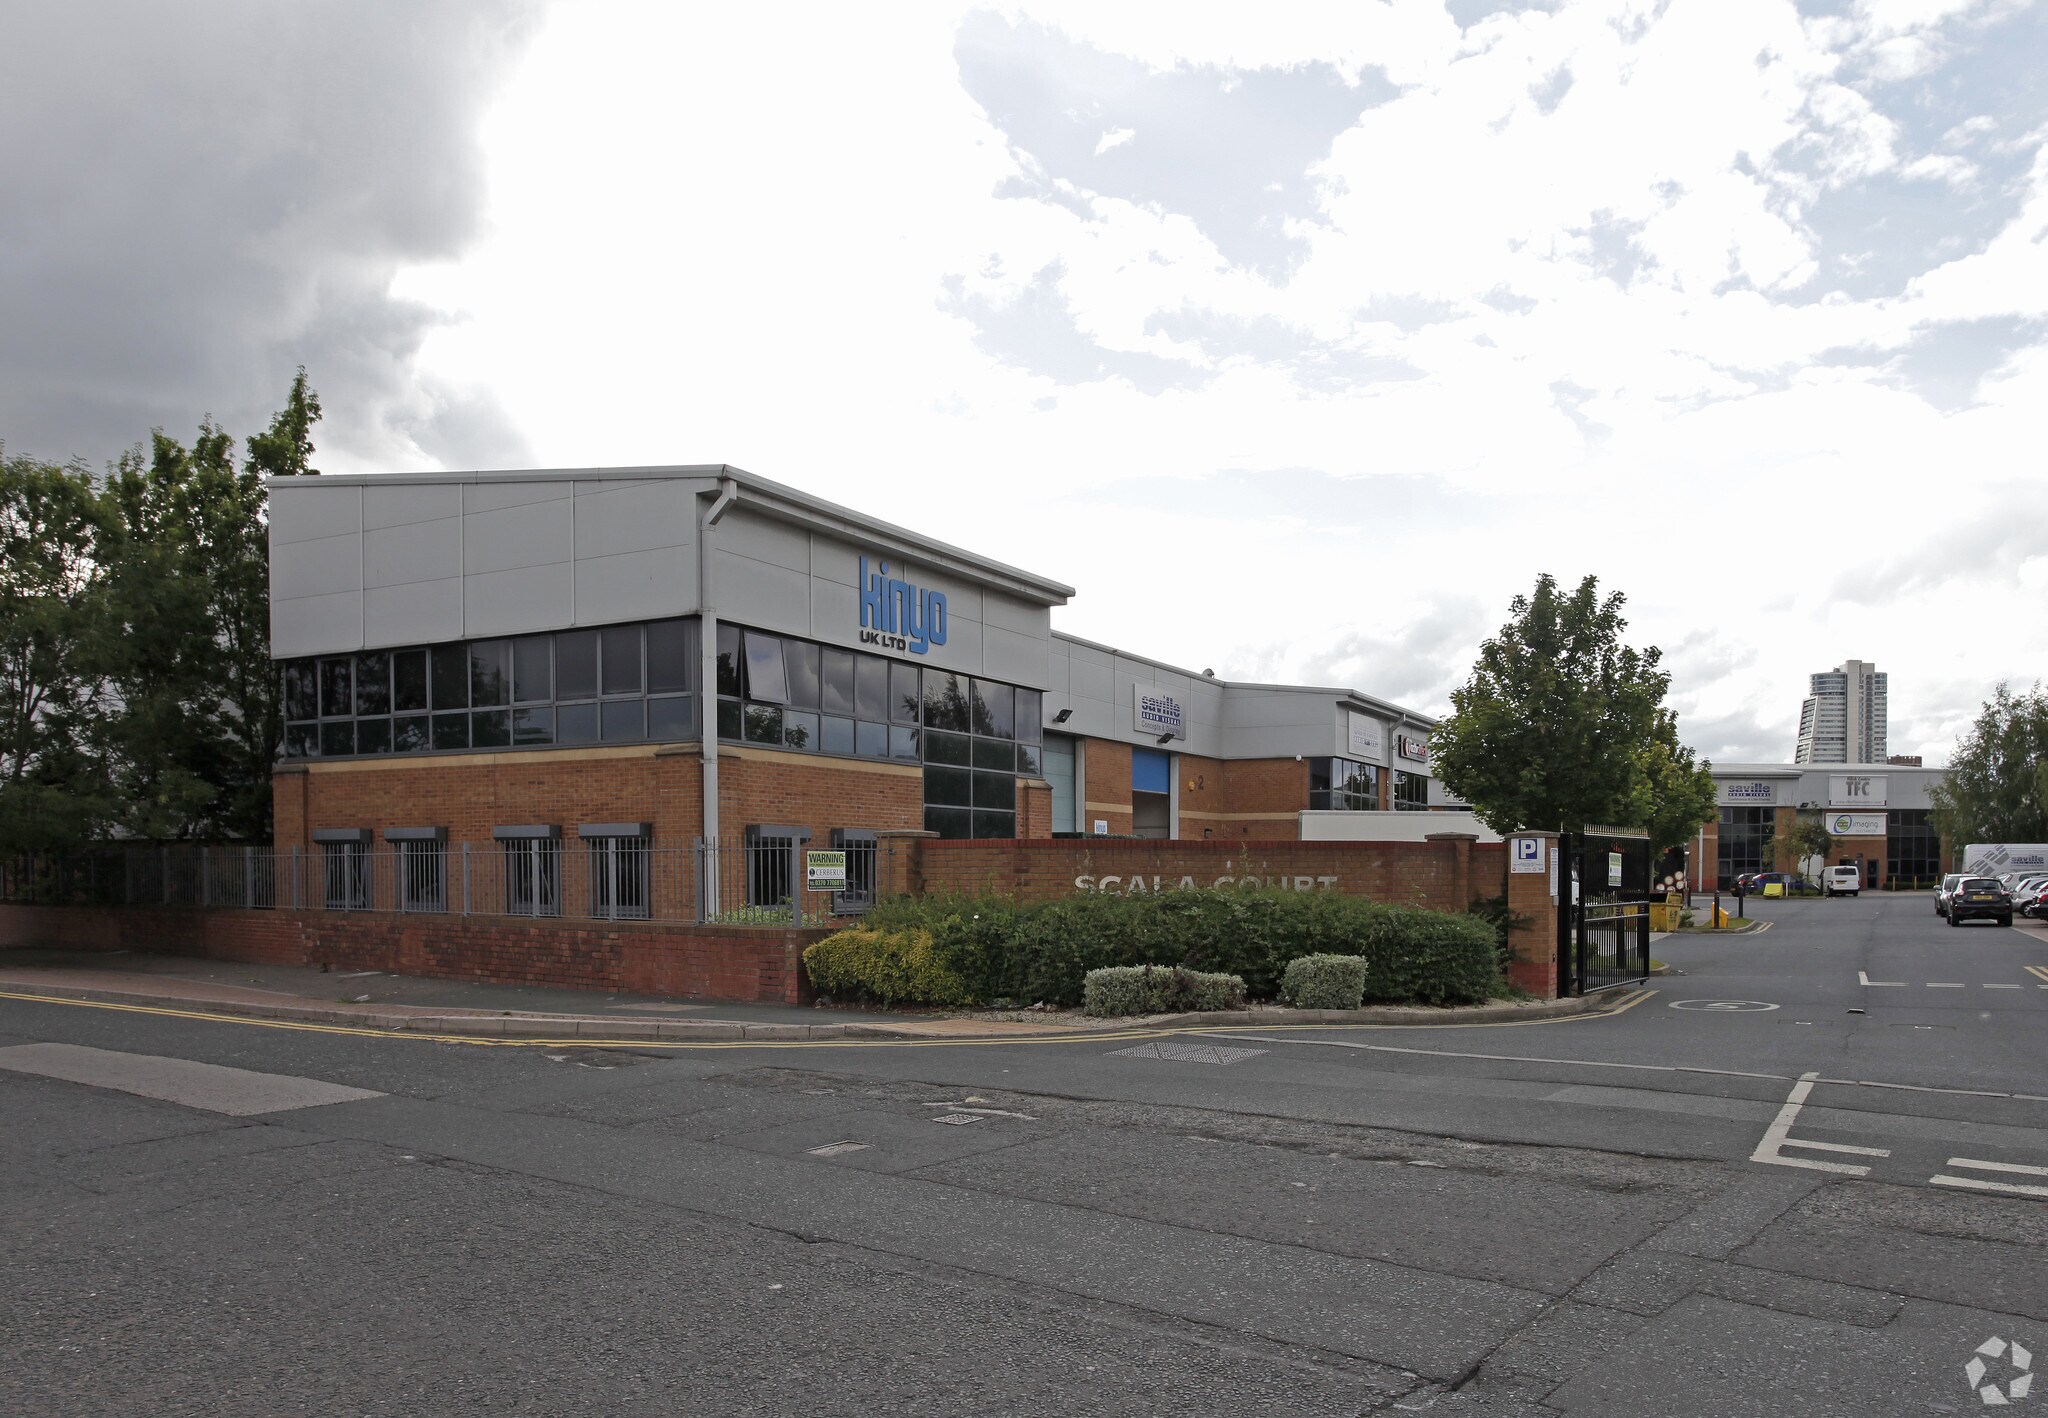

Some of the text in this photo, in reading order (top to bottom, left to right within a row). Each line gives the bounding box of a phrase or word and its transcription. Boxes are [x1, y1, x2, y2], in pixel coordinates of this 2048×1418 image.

[860, 555, 947, 654] kinyo
[860, 630, 906, 651] UK LTD
[1142, 695, 1180, 717] saville
[1142, 712, 1181, 726] AUDIO VISUAL
[1198, 775, 1204, 790] 2
[1728, 782, 1770, 792] saville
[1846, 781, 1870, 796] TFC
[1520, 839, 1536, 859] P
[809, 853, 844, 863] WARNING
[816, 868, 844, 876] CERBERUS
[1074, 875, 1197, 898] SCALA
